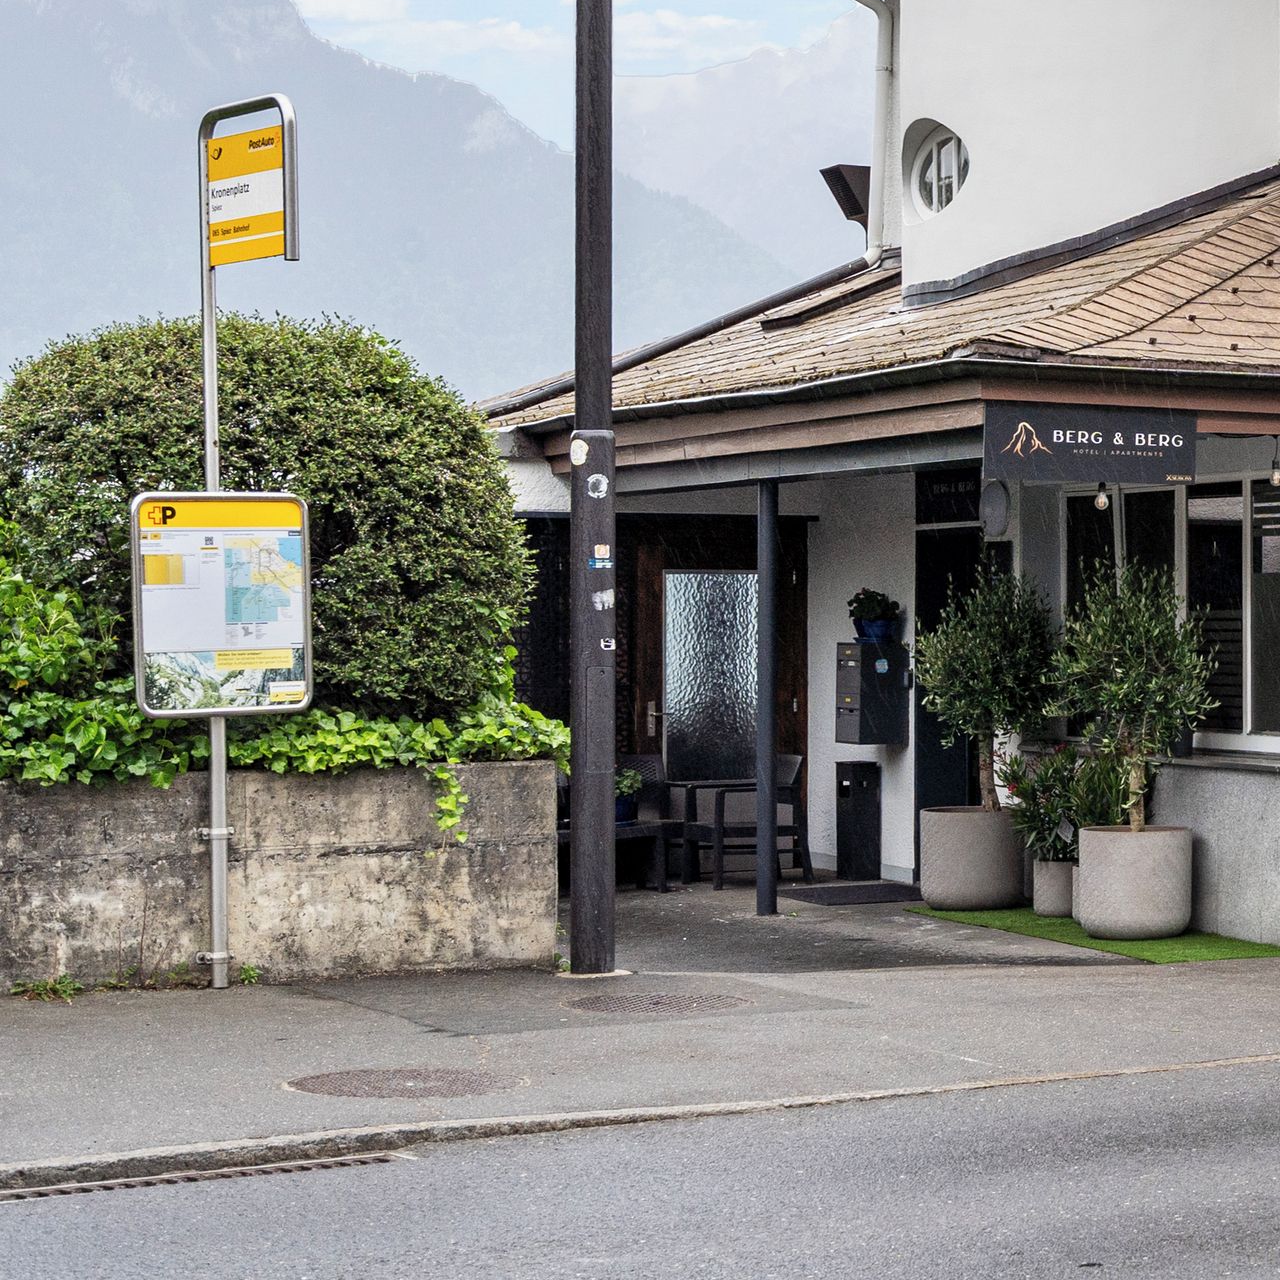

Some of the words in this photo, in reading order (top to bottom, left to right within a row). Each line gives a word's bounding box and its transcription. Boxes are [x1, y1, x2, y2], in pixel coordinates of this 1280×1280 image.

[249, 137, 275, 150] PostAuto
[211, 183, 250, 199] Kronenplatz
[1053, 429, 1103, 444] BERG
[1113, 432, 1124, 445] &
[1135, 433, 1184, 447] BERG
